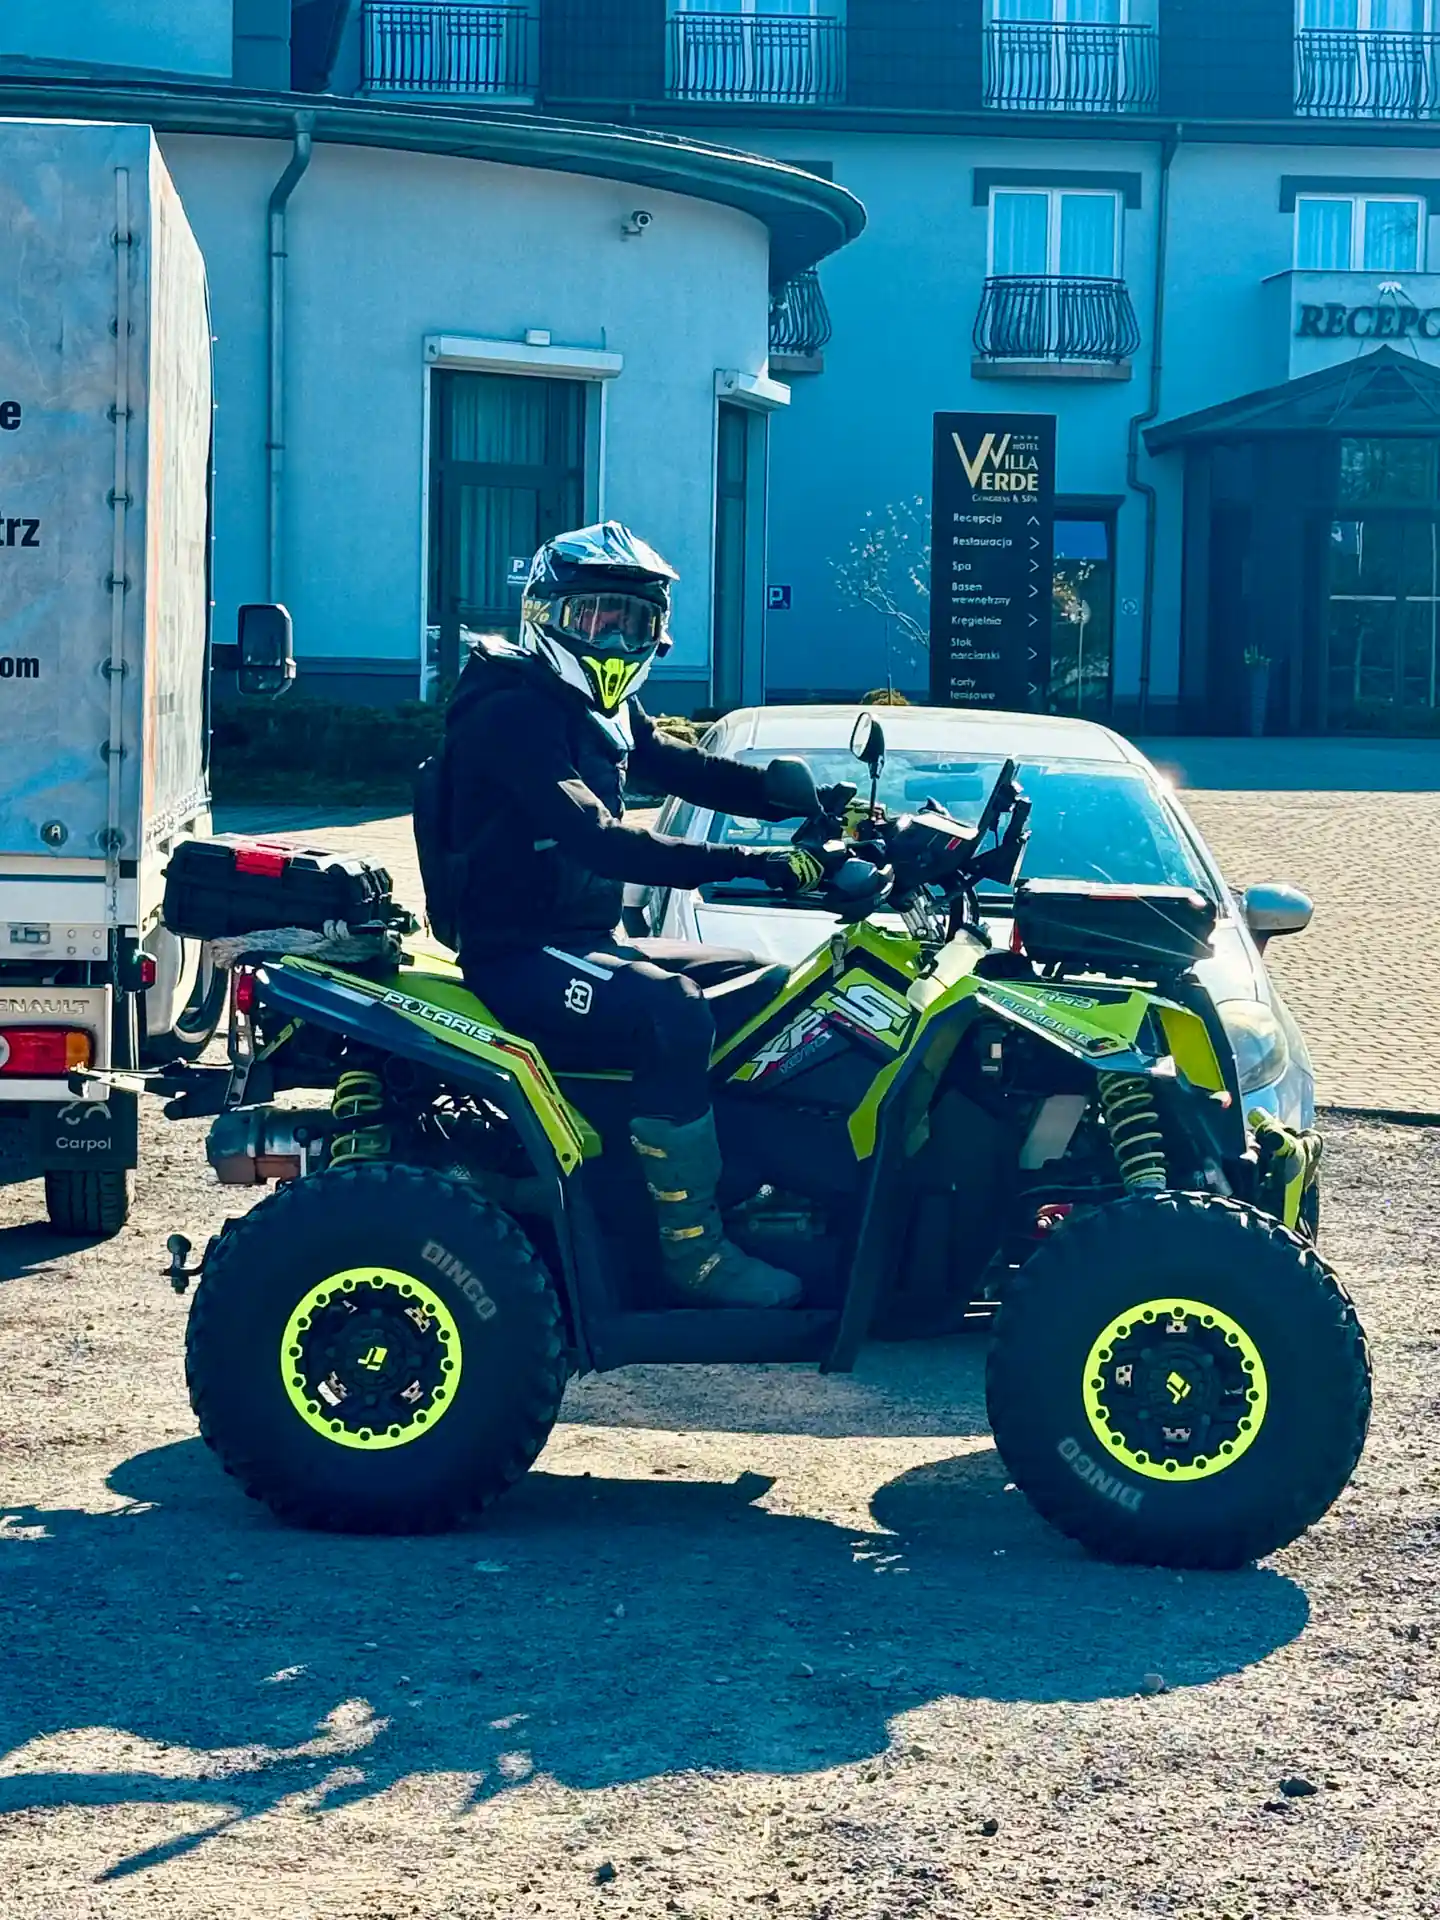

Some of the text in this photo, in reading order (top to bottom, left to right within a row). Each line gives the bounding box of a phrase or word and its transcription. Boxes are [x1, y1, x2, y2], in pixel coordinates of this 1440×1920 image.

[1012, 443, 1039, 451] HOTEL
[953, 512, 1003, 525] Recepcja
[952, 536, 1013, 549] Restauracja
[512, 559, 525, 573] P
[952, 560, 972, 572] Spa
[951, 582, 983, 592] Basen
[769, 587, 784, 606] P
[383, 990, 495, 1042] POLARIS
[56, 1136, 112, 1152] Carpol
